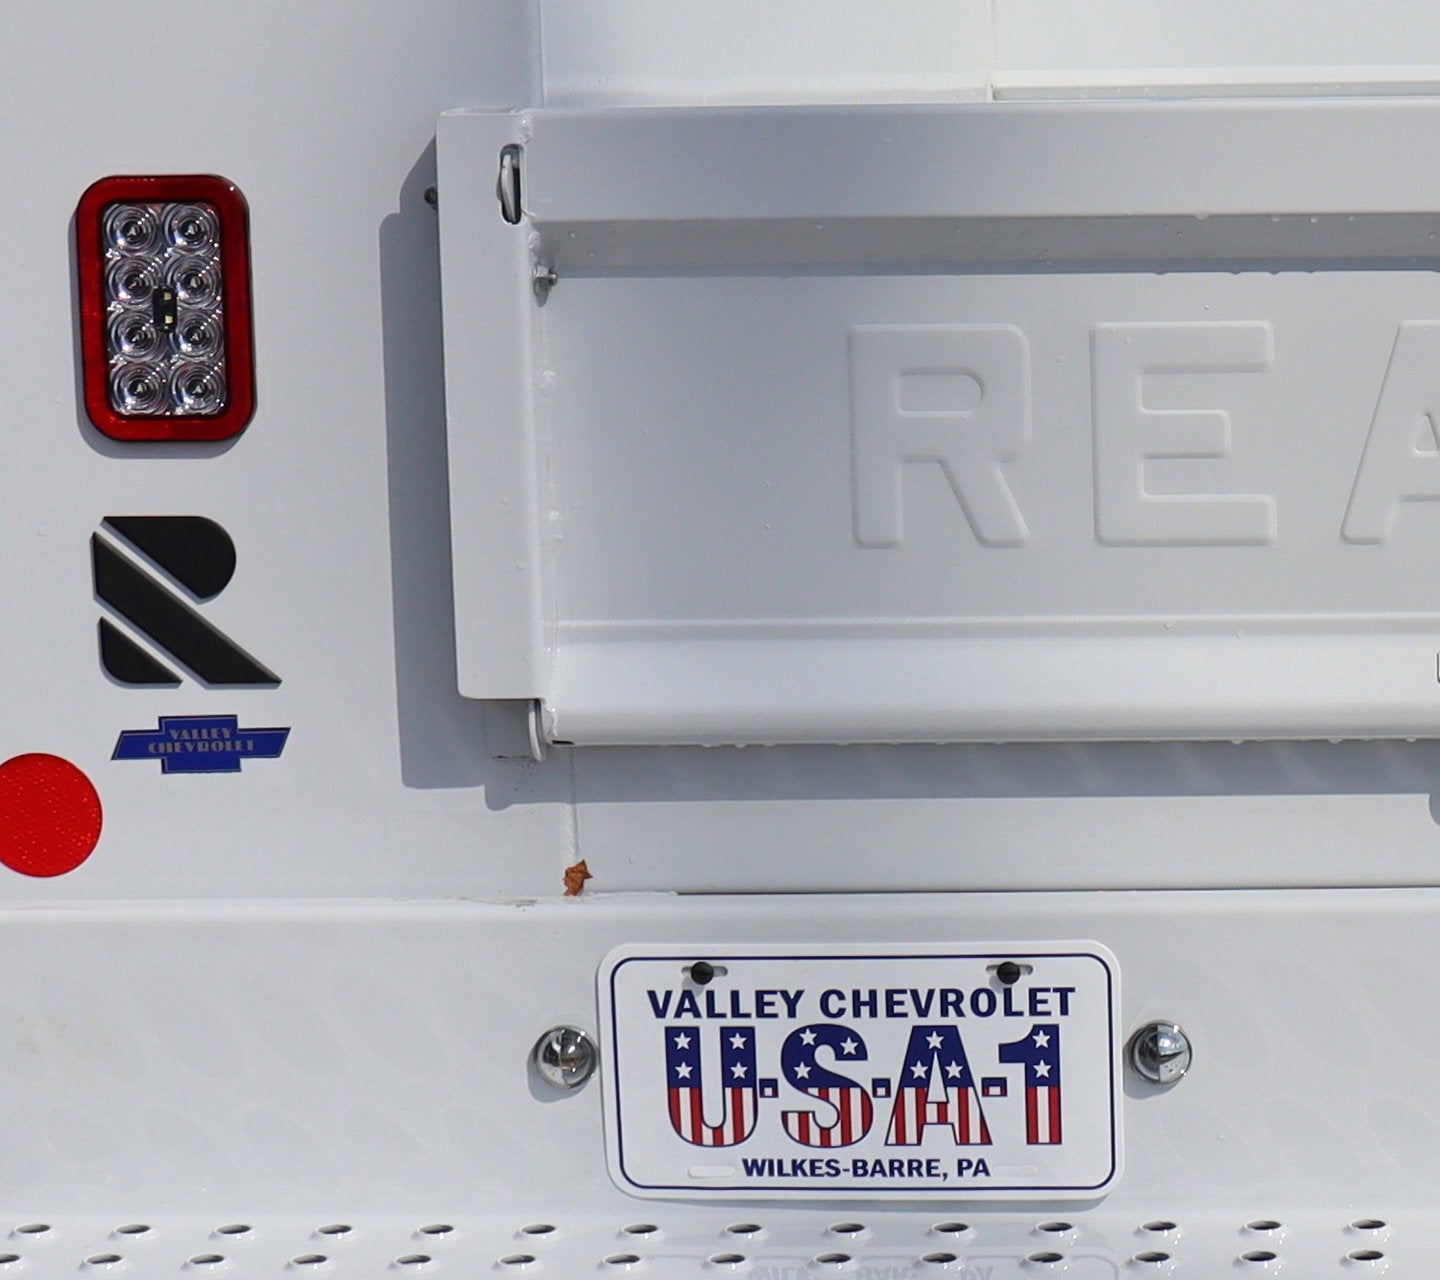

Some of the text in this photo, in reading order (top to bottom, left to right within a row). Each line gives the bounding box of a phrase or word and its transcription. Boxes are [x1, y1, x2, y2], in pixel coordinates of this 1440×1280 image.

[168, 727, 232, 740] VALLEY
[147, 740, 255, 754] CHEVROLET
[646, 985, 1076, 1020] VALLEY CHEVROLET
[741, 1157, 991, 1182] WILKES-BARRE, PA
